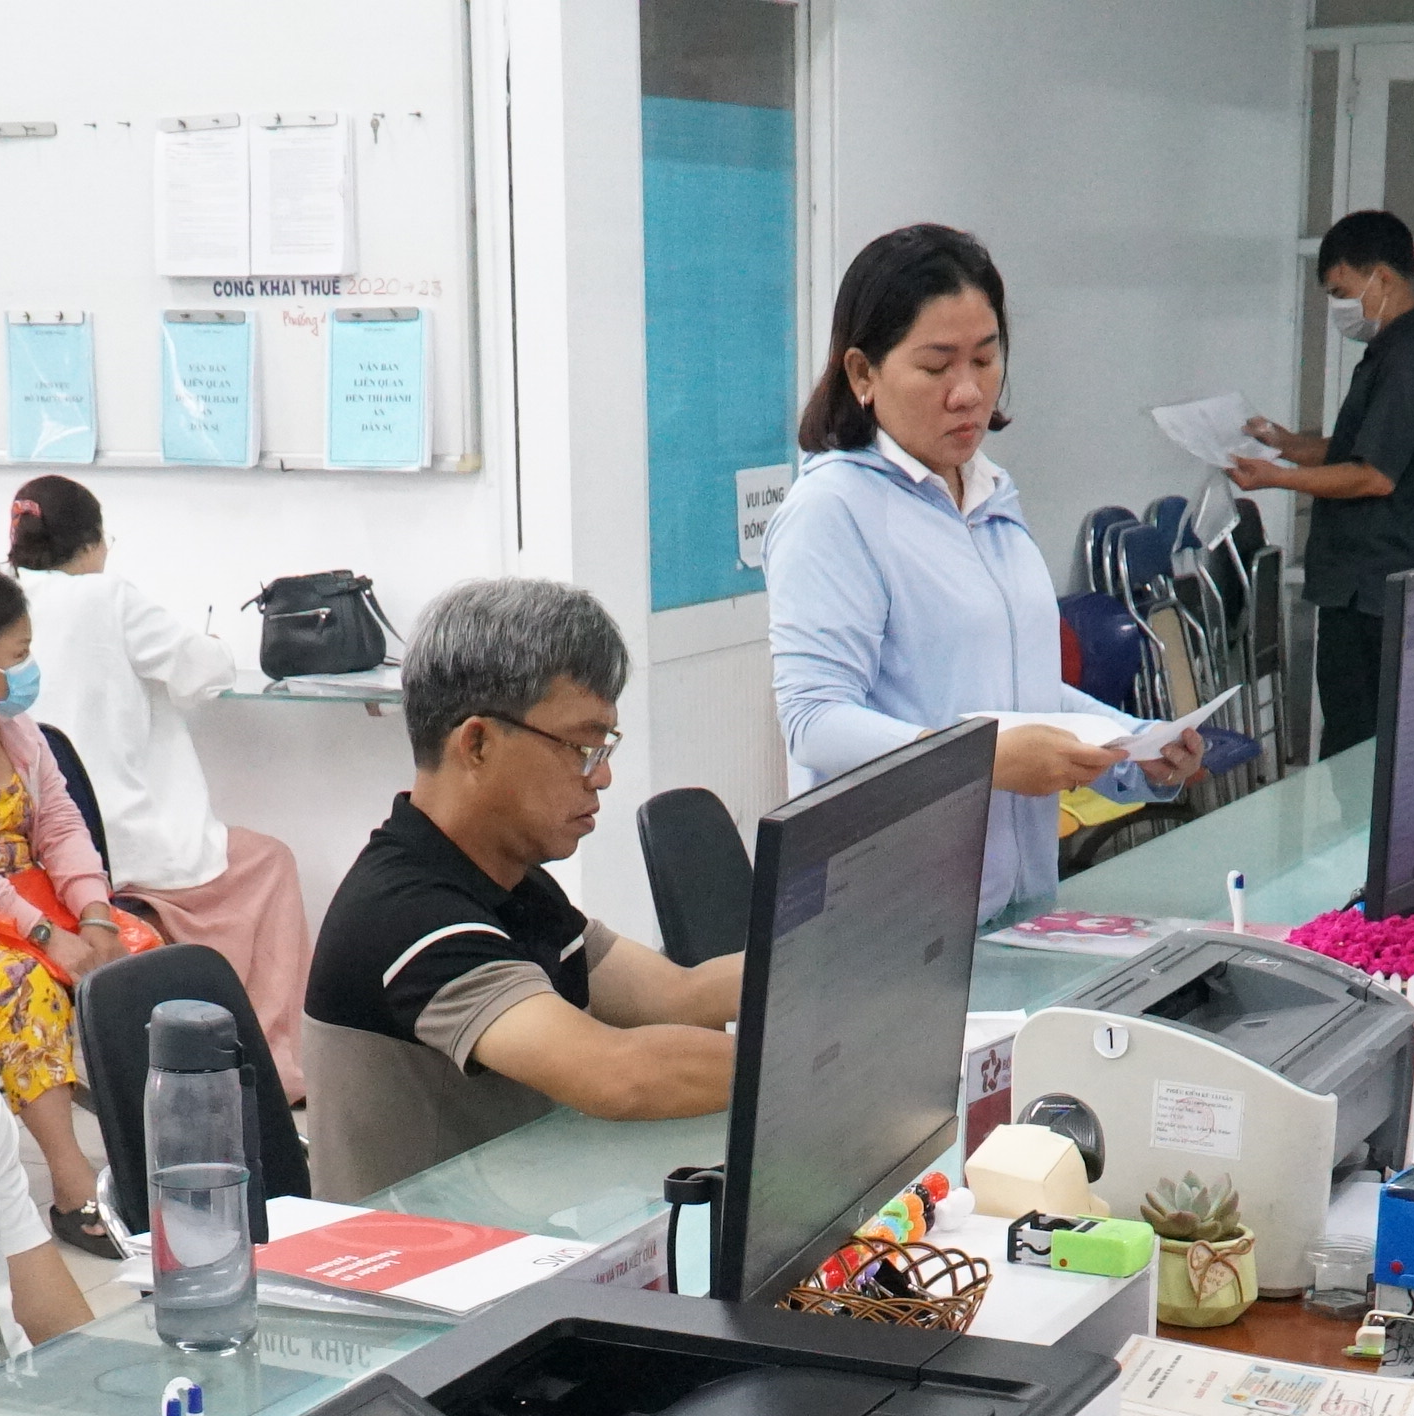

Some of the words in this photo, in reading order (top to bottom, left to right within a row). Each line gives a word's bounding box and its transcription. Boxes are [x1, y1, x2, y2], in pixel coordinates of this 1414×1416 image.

[259, 279, 295, 297] KHAI
[746, 490, 760, 508] VUI
[761, 485, 785, 506] LÒNG
[1106, 1027, 1114, 1050] 1
